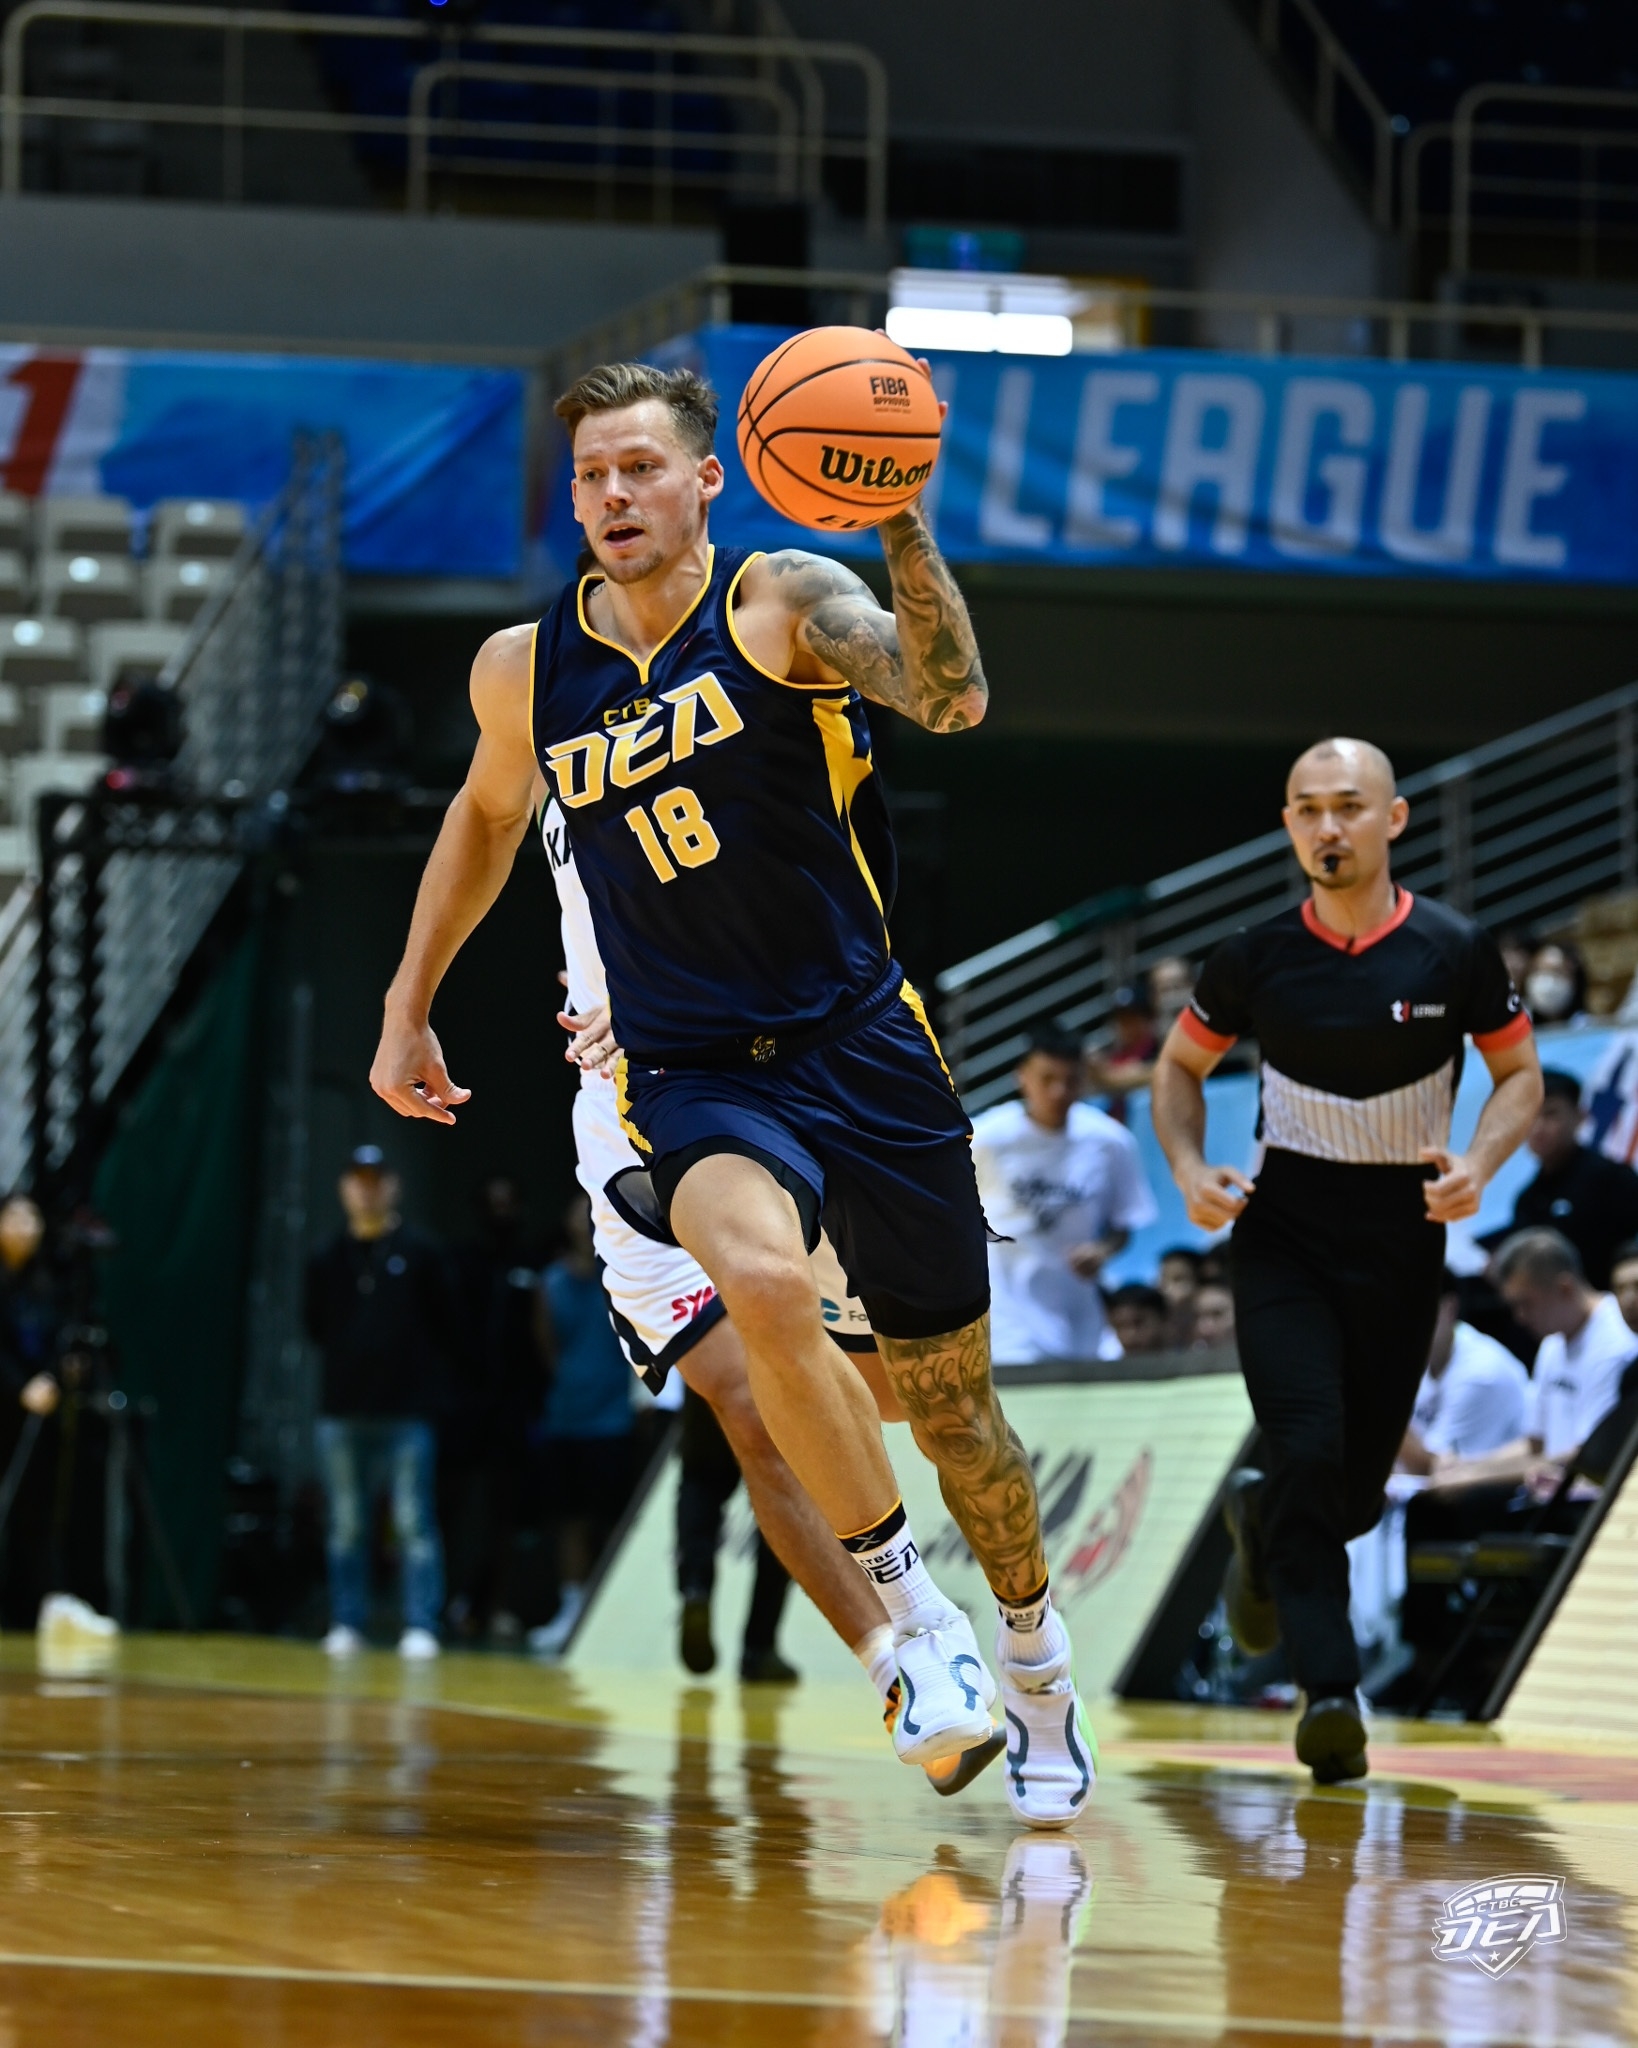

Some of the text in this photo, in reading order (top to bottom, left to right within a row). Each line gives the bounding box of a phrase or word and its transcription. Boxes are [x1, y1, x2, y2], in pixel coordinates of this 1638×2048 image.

[870, 375, 909, 396] FIBA
[819, 445, 934, 489] Wilson
[977, 366, 1587, 568] LEAGUE
[545, 671, 744, 809] DEA
[624, 786, 721, 884] 18
